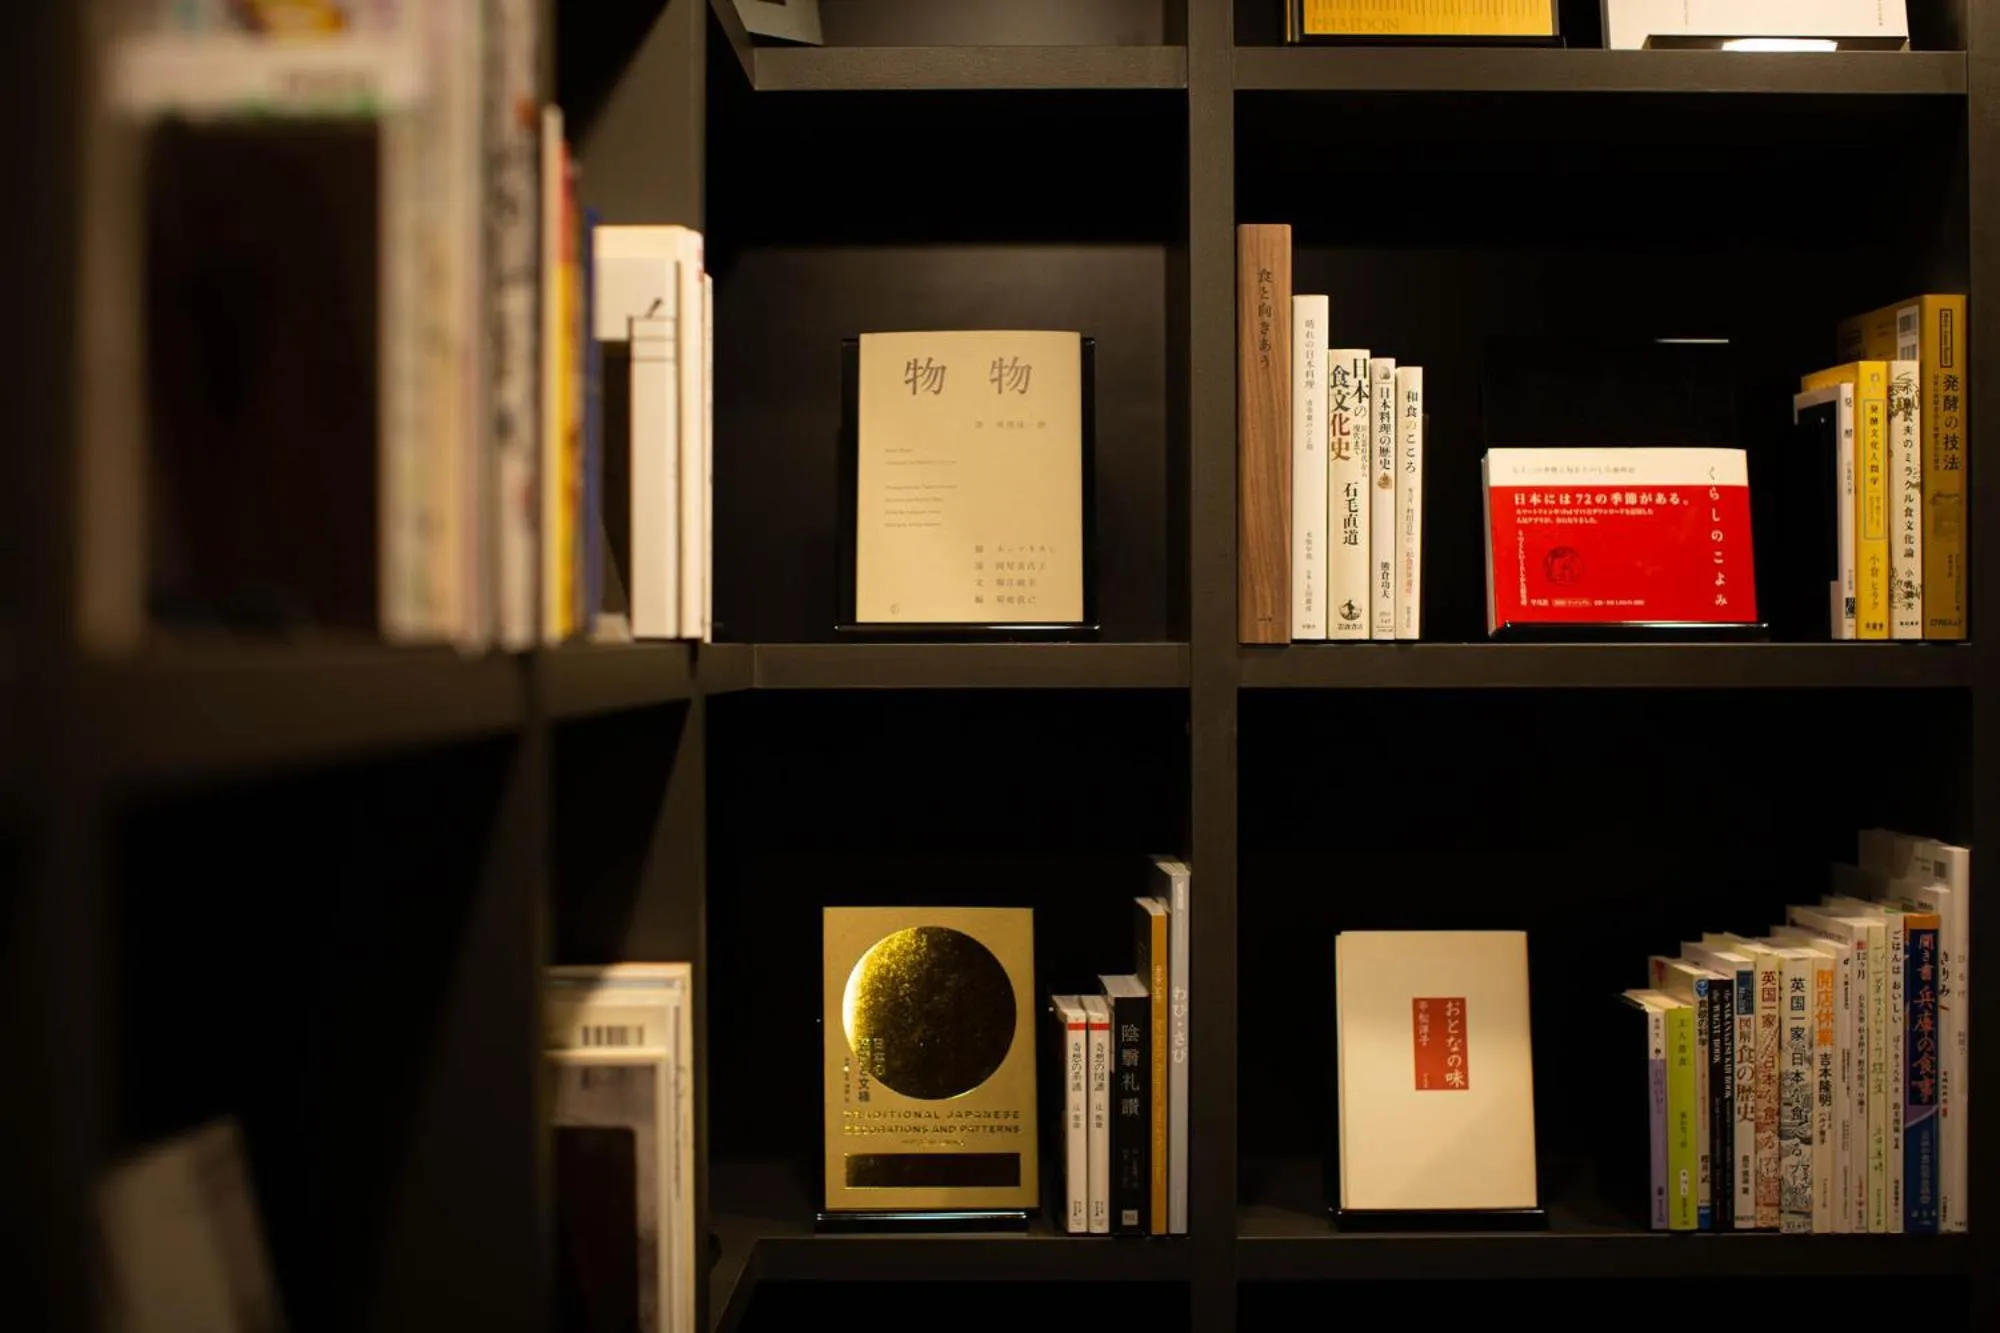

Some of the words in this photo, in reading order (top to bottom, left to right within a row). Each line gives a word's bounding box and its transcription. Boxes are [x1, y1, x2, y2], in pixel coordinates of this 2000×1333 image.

[1310, 17, 1400, 33] PHAIDON
[904, 356, 947, 396] 物
[989, 356, 1033, 395] 物
[1351, 358, 1369, 418] 日本の
[1330, 364, 1350, 462] 食文化史
[1379, 388, 1391, 470] 日本料理の歴史
[1405, 391, 1418, 473] 和食のこころ
[1943, 374, 1960, 471] 発酵の技法
[1343, 481, 1359, 546] 石毛直道
[1708, 465, 1728, 606] くらしのこよみ
[1816, 969, 1835, 1047] 開店休業
[1939, 951, 1950, 997] きりみ
[1445, 1000, 1465, 1088] おとなの味
[1736, 1017, 1755, 1123] 図解食の歴史
[1819, 1052, 1833, 1107] 吉本隆明
[932, 1124, 955, 1134] AND
[959, 1124, 1022, 1134] PATTERNS
[946, 1110, 1021, 1120] JAPANESE
